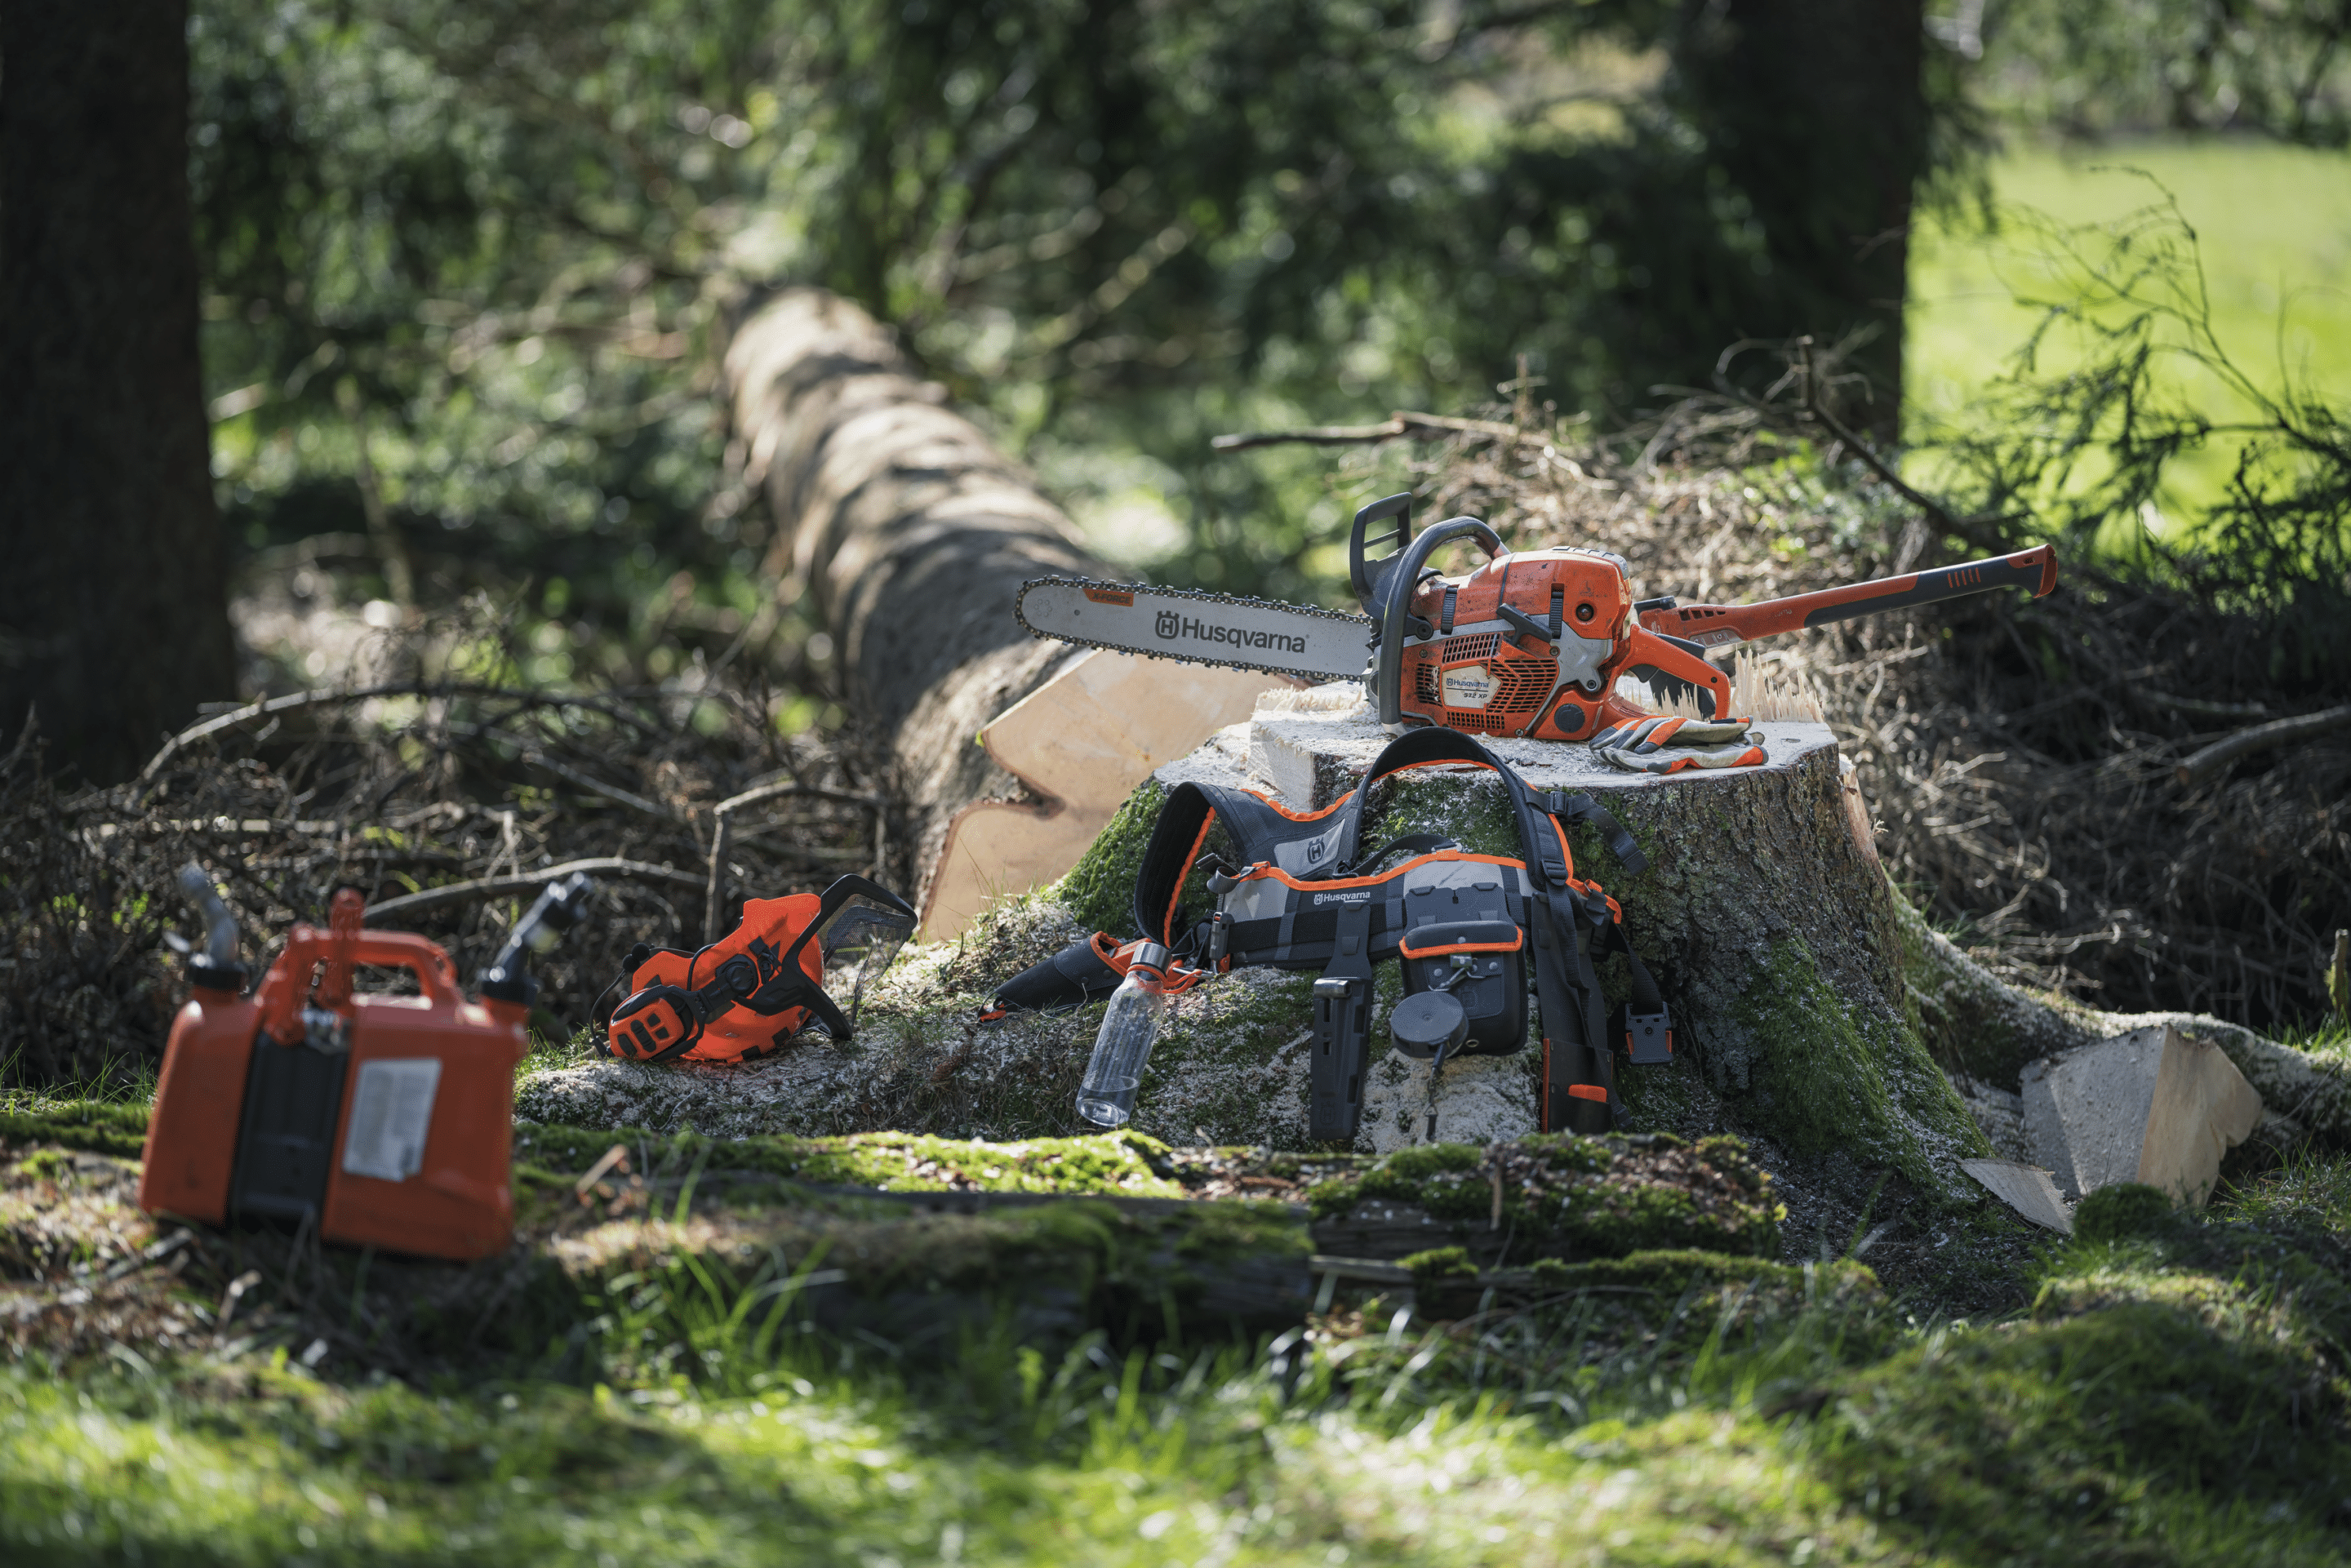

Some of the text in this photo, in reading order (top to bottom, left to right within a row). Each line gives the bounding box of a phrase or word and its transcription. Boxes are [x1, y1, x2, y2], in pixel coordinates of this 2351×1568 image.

[1092, 592, 1131, 604] X-FORCE
[1182, 617, 1305, 653] Husqvarna
[1453, 679, 1489, 687] Husqvarna
[1323, 891, 1371, 903] Husqvarna
